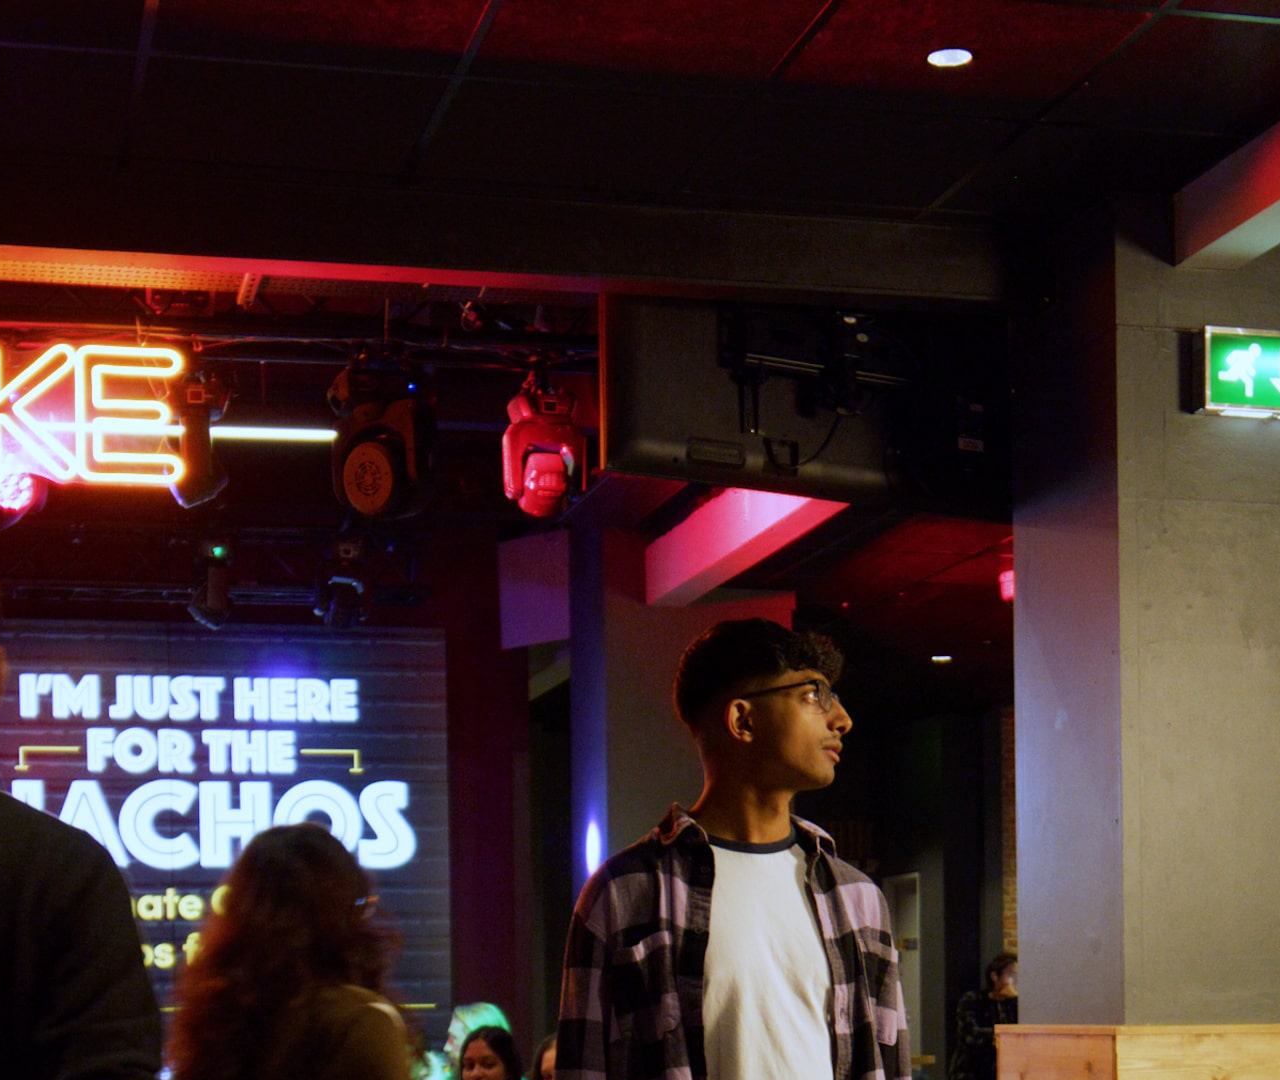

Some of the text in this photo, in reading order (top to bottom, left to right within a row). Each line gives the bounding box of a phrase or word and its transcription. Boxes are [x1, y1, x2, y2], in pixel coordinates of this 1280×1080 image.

[18, 672, 360, 723] I'M JUST HERE
[85, 727, 297, 774] FOR THE
[11, 778, 418, 871] ACHOS
